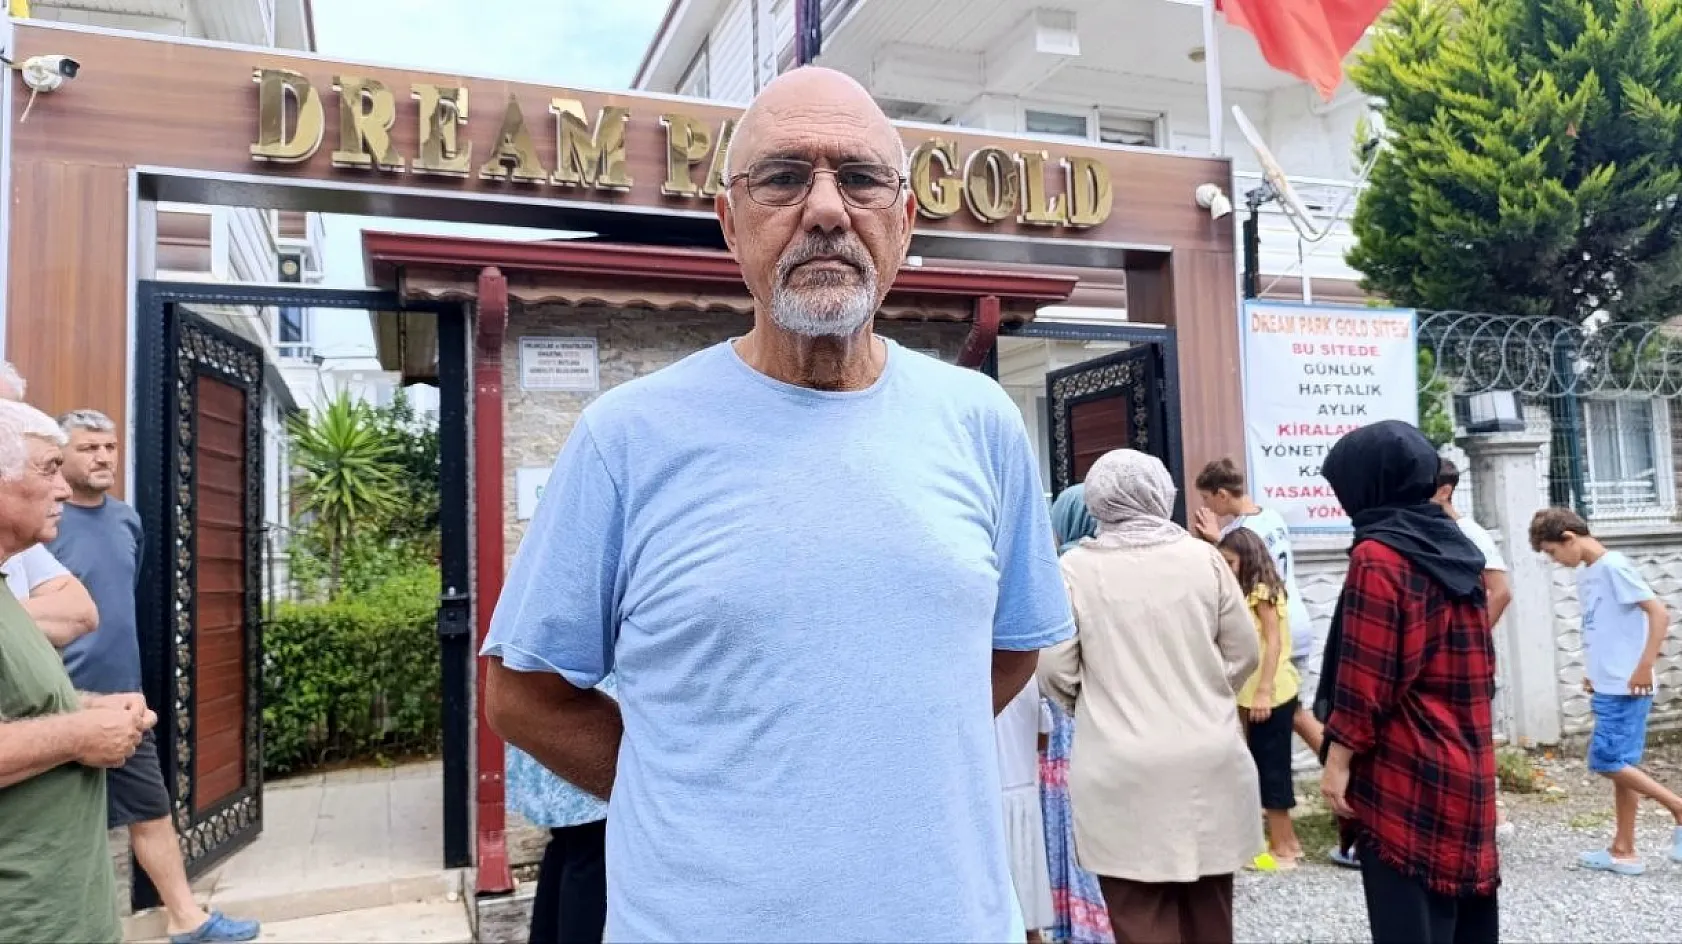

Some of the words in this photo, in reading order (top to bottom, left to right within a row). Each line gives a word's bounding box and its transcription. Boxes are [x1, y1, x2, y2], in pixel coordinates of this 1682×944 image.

[250, 66, 633, 191] DREAM
[659, 114, 735, 198] PA
[909, 136, 1113, 229] GOLD
[1251, 311, 1295, 333] DREAM
[1299, 315, 1331, 336] PARK
[1335, 318, 1368, 337] GOLD
[1292, 343, 1314, 355] BU
[1303, 362, 1375, 376] GÜNLÜK
[1299, 383, 1382, 396] HAFTALIK
[1317, 403, 1368, 416] AYLIK
[1298, 465, 1323, 477] KA
[1264, 485, 1336, 498] YASAKL
[1307, 504, 1344, 518] YÖN
